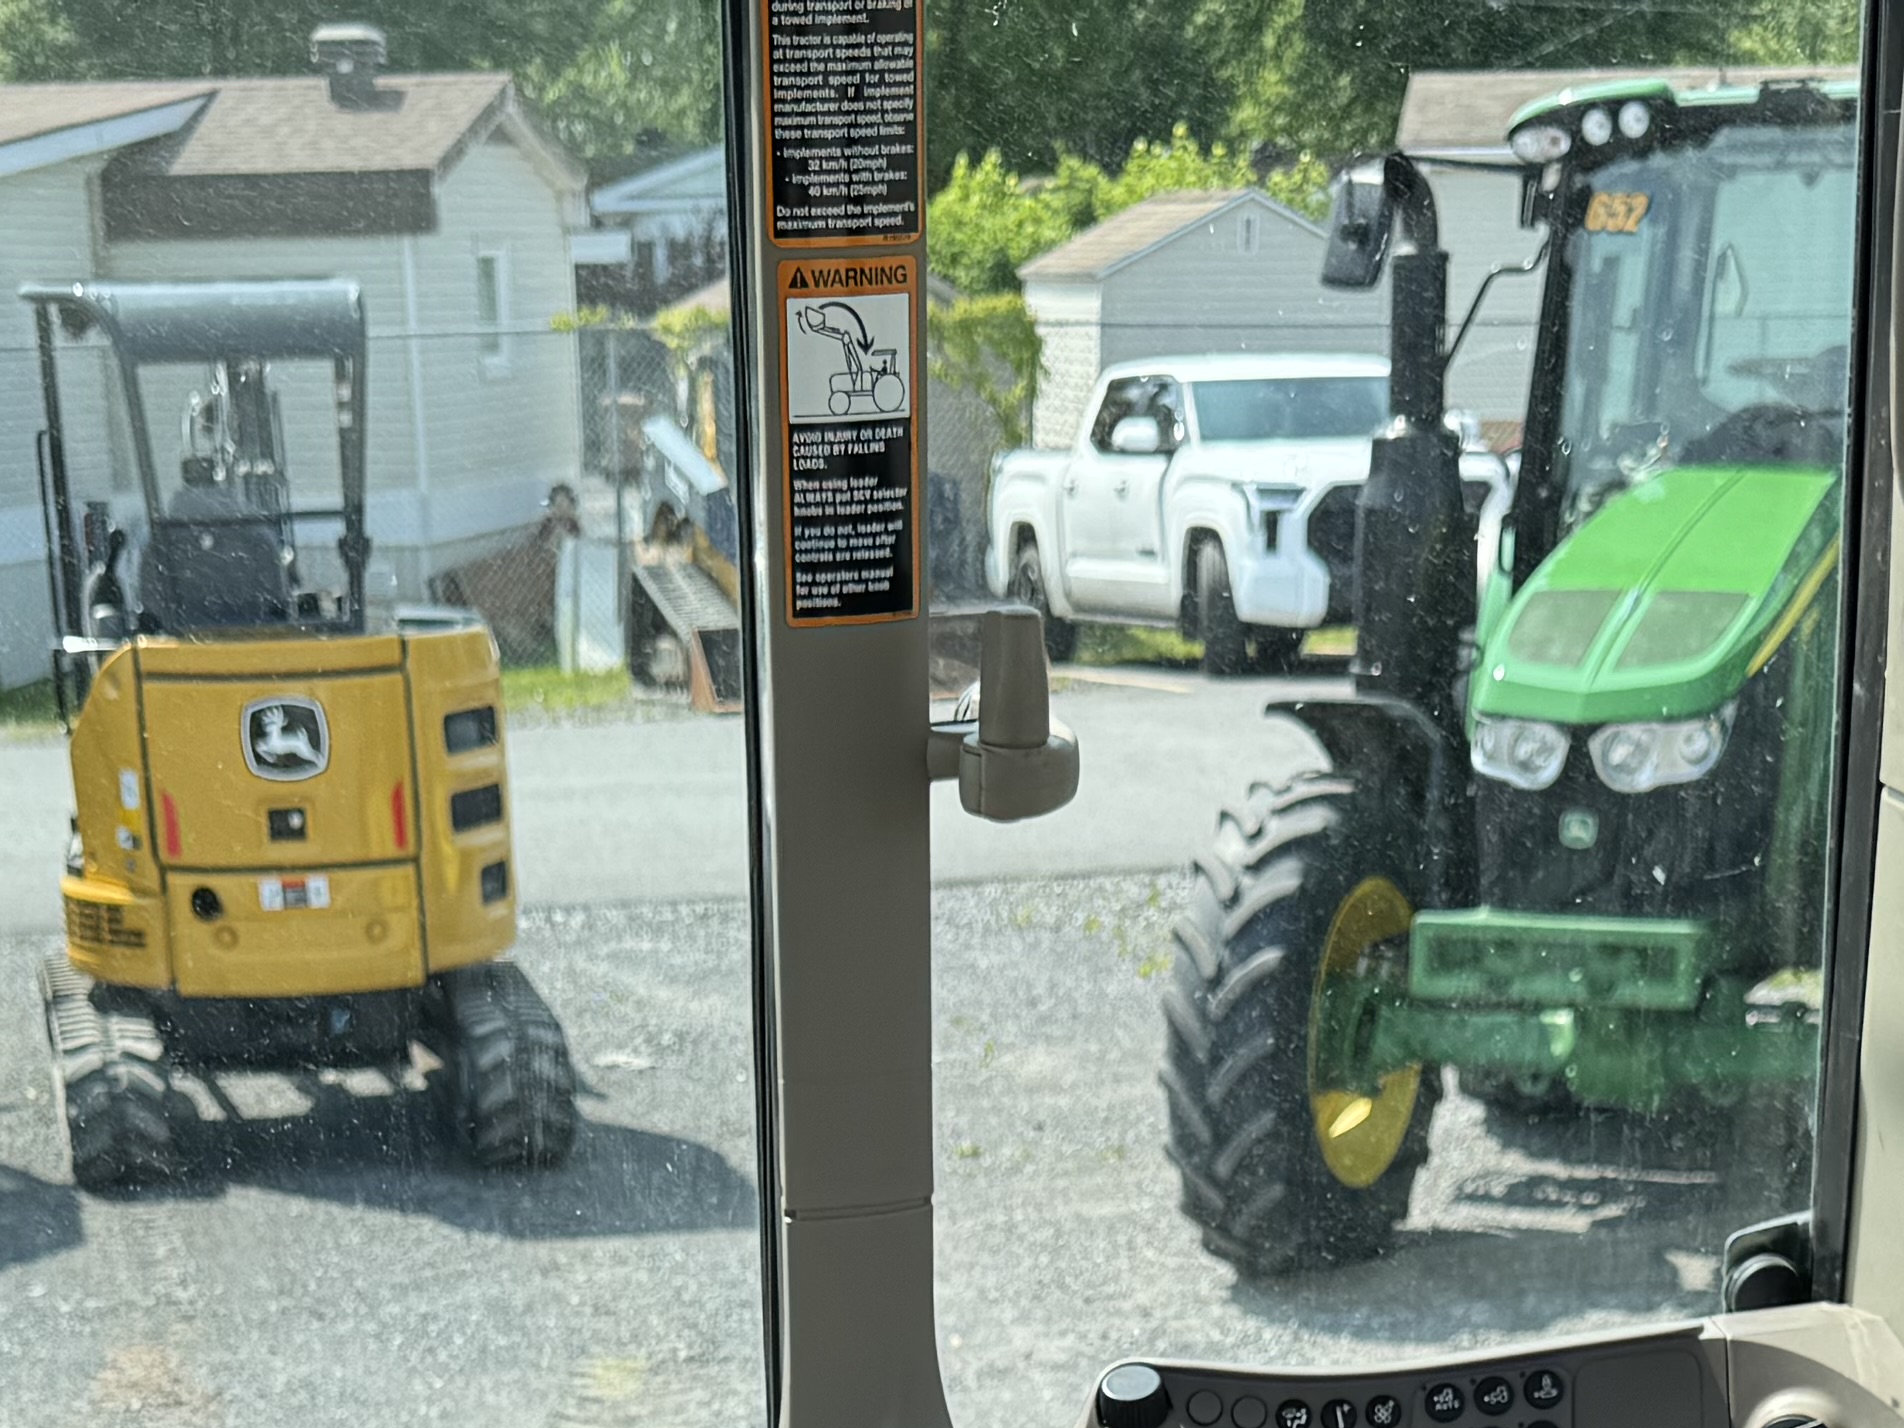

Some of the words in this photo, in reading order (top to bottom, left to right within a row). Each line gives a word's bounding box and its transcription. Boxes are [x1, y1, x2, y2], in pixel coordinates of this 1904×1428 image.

[807, 0, 852, 12] transport
[772, 16, 778, 25] a
[781, 15, 812, 25] towed
[772, 34, 791, 45] This
[793, 34, 821, 45] tractor
[823, 34, 830, 44] is
[833, 33, 865, 46] capable
[867, 32, 875, 44] of
[773, 48, 783, 59] at
[786, 48, 833, 59] transport
[836, 46, 871, 59] speeds
[874, 46, 892, 56] that
[894, 46, 914, 57] may
[773, 61, 808, 72] exceed
[810, 60, 825, 72] the
[827, 59, 872, 71] maximum
[774, 74, 822, 87] transport
[828, 72, 860, 86] speed
[865, 72, 879, 83] for
[885, 70, 914, 82] towed
[774, 101, 840, 112] manufacturer
[841, 100, 864, 111] does
[866, 100, 881, 110] not
[883, 98, 914, 111] specify
[774, 115, 816, 126] maximum
[818, 114, 855, 125] transport
[775, 128, 802, 139] these
[804, 127, 848, 140] transport
[850, 125, 877, 138] speed
[784, 147, 841, 160] Implements
[844, 144, 879, 156] without
[881, 143, 914, 154] brakes:
[808, 160, 820, 171] 32
[822, 159, 847, 170] km/h
[792, 172, 849, 185] Implements
[852, 171, 872, 182] with
[874, 170, 907, 181] brakes:
[808, 186, 820, 196] 40
[822, 185, 848, 196] km/h
[777, 205, 791, 217] Do
[793, 205, 809, 216] not
[811, 204, 844, 216] exceed
[847, 204, 861, 214] the
[777, 219, 826, 230] maximum
[828, 216, 872, 229] transport
[874, 215, 904, 228] speed.
[811, 266, 908, 288] WARNING
[860, 428, 872, 440] OR
[875, 427, 903, 439] DEATH
[793, 444, 830, 457] CAUSED
[793, 458, 828, 470] LOADS.
[850, 475, 878, 488] loader
[794, 491, 833, 503] ALWAYS
[836, 490, 850, 505] put
[804, 527, 821, 539] you
[824, 525, 835, 536] do
